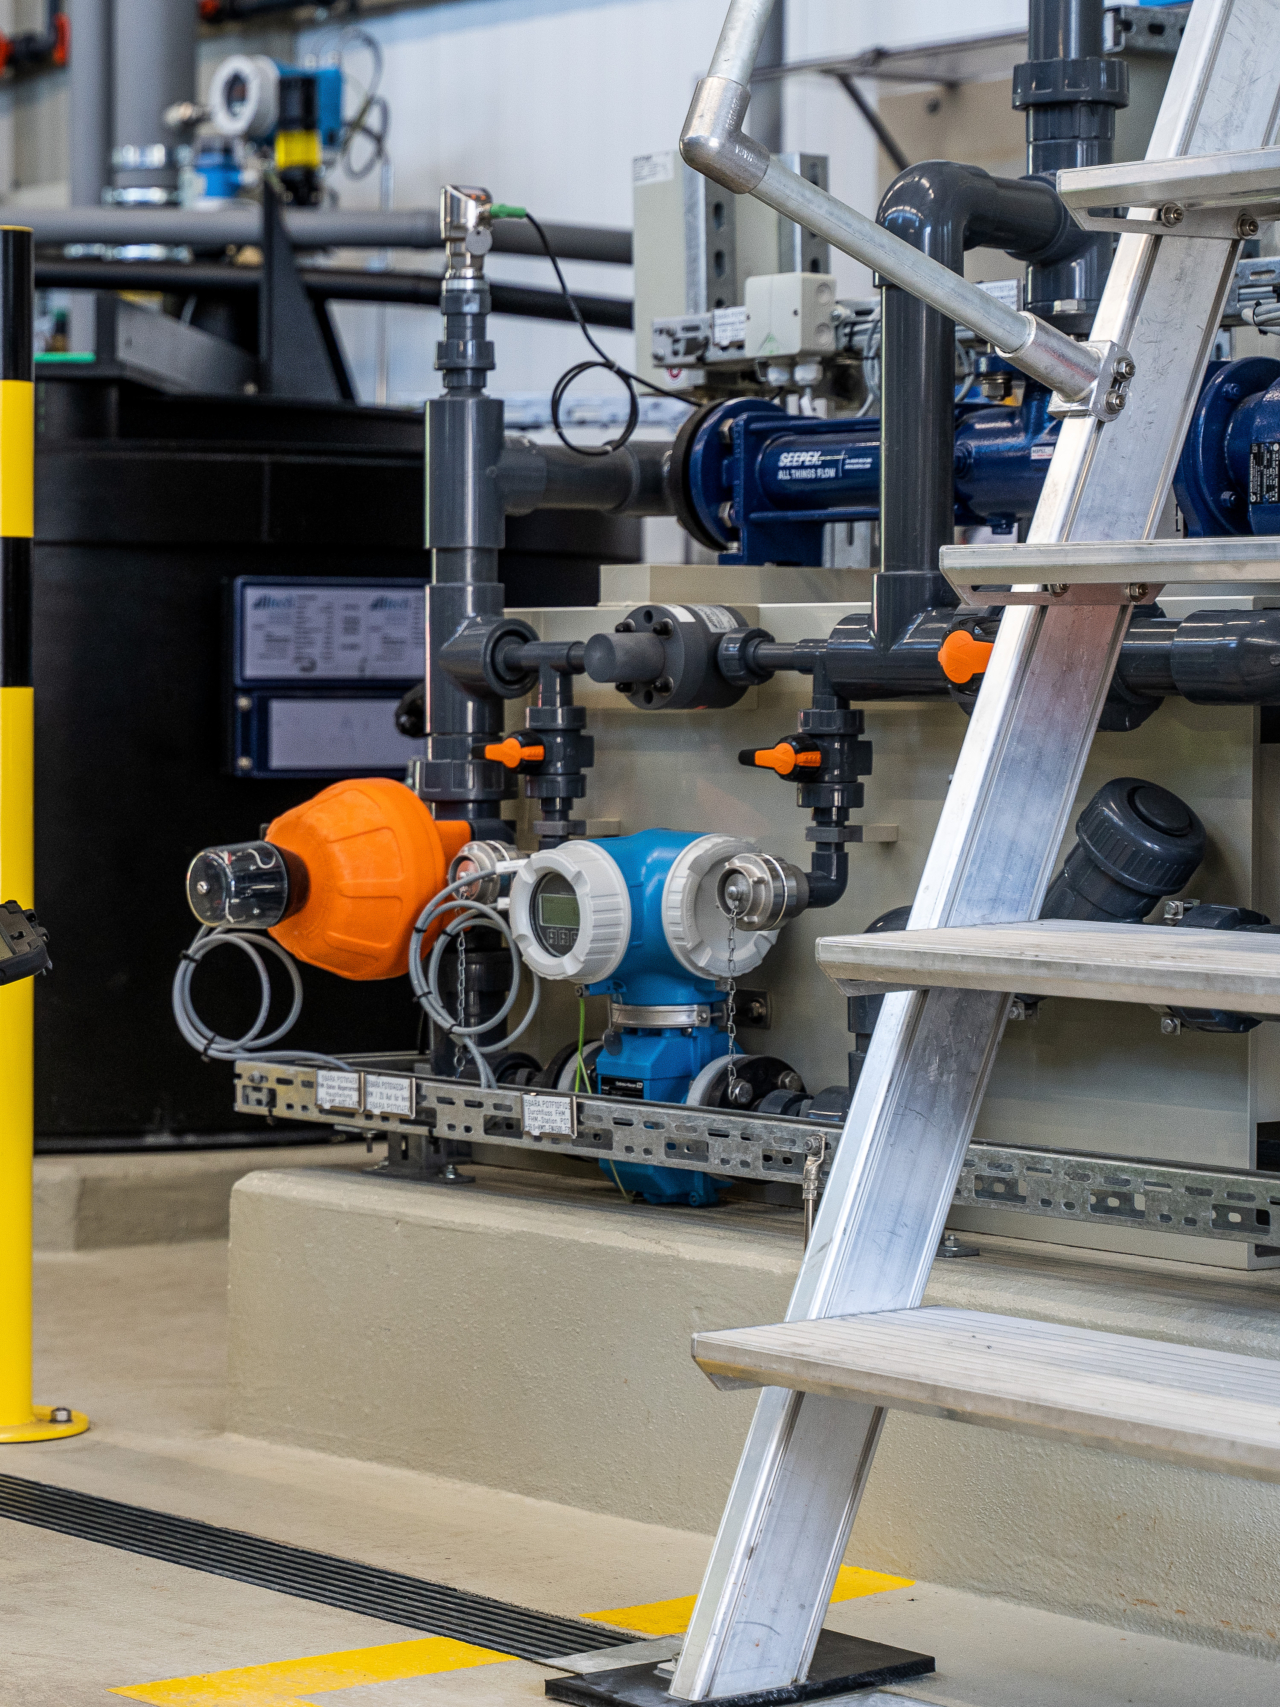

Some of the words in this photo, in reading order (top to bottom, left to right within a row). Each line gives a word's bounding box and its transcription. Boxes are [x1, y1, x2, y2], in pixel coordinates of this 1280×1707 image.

[778, 469, 791, 480] ALL
[791, 468, 816, 479] THINGS
[817, 467, 836, 479] FLOW
